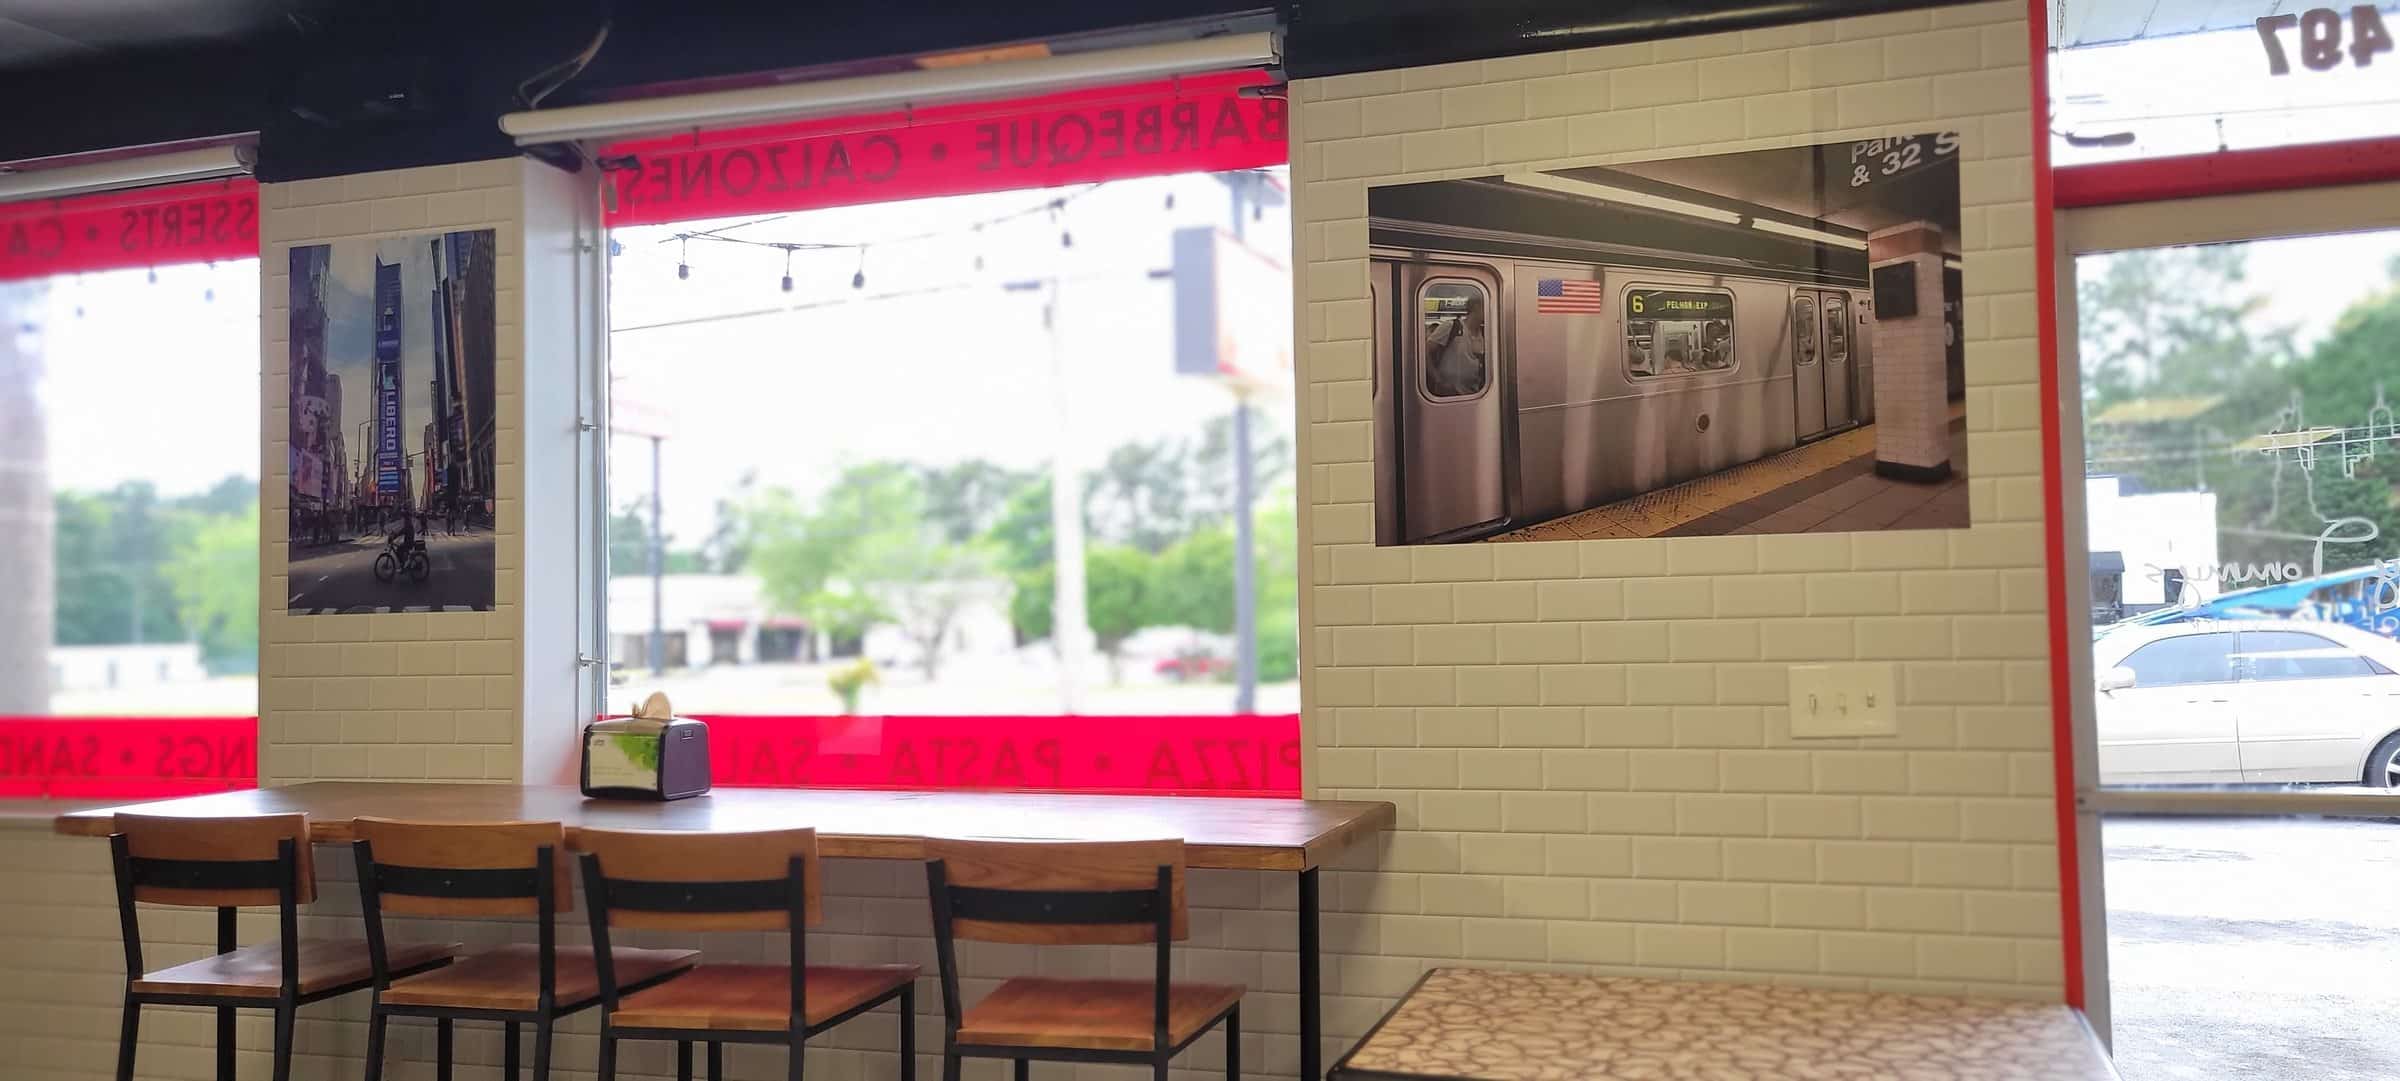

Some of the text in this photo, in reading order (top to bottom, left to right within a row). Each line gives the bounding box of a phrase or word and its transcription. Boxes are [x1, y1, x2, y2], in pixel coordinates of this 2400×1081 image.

[1850, 164, 1871, 187] &
[1881, 143, 1921, 176] 32
[1632, 295, 1644, 313] 6
